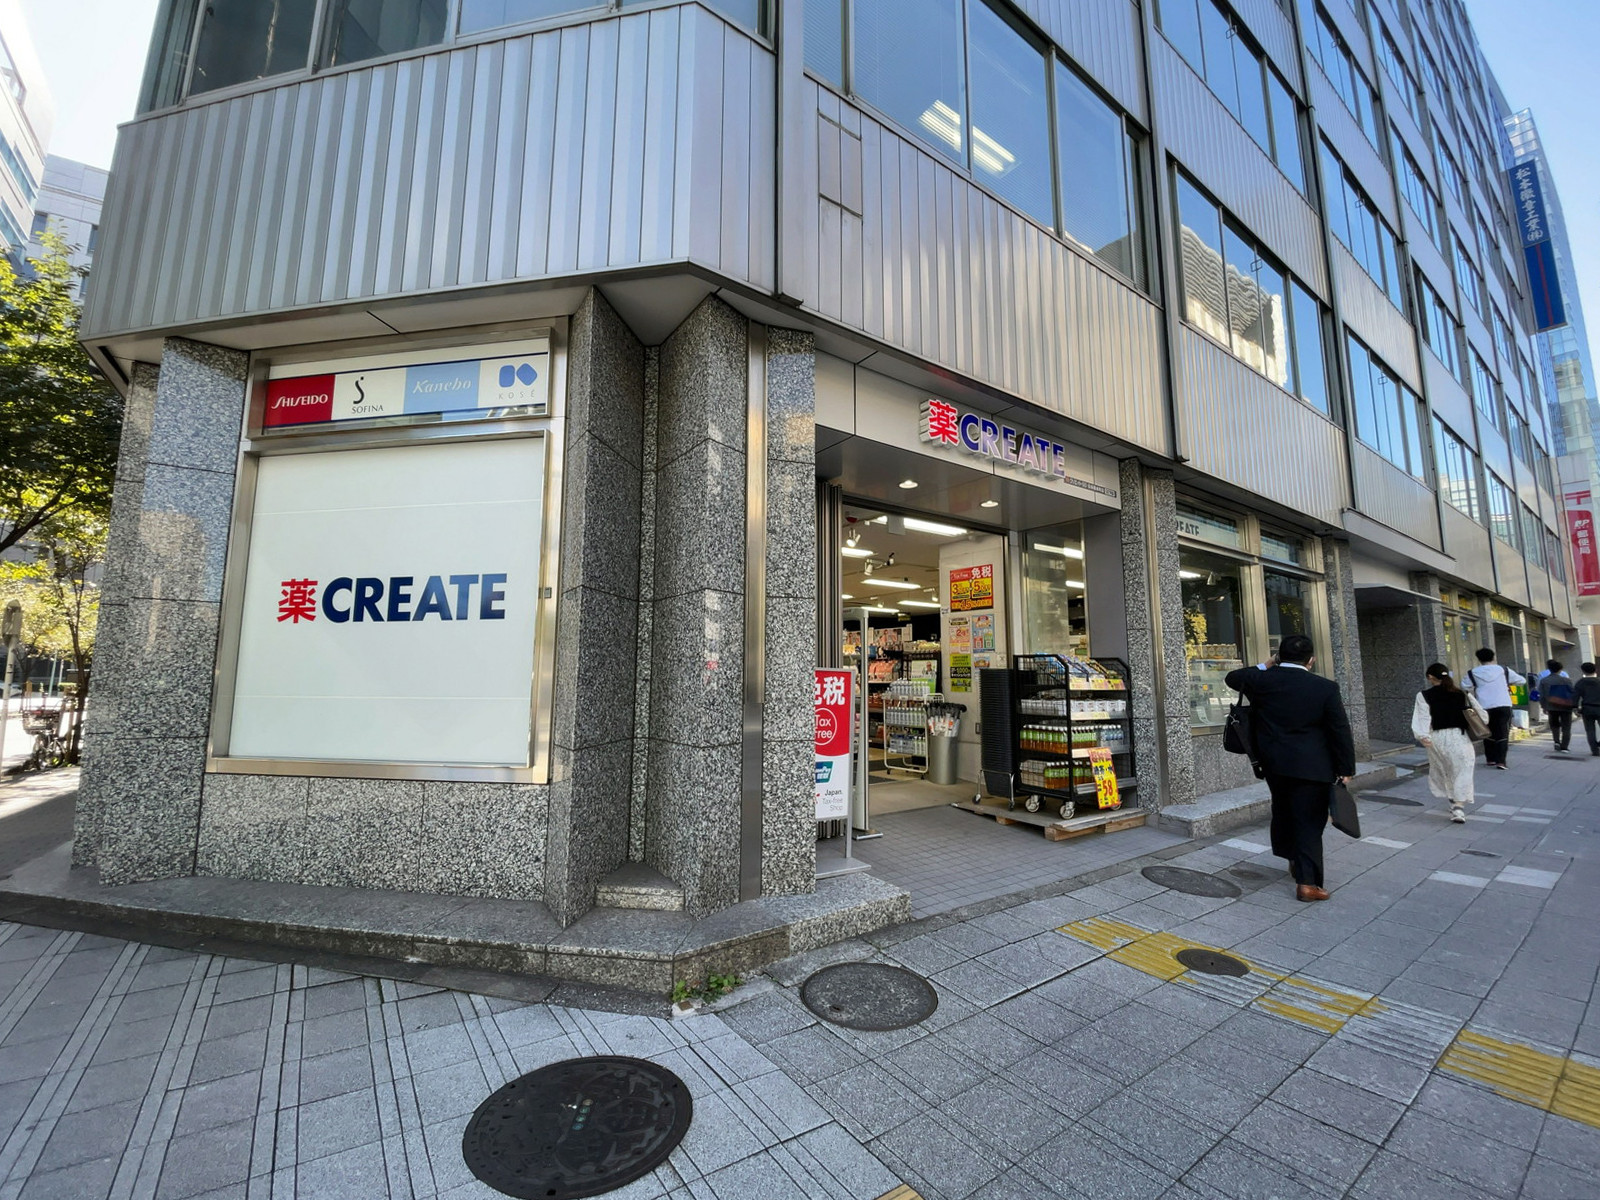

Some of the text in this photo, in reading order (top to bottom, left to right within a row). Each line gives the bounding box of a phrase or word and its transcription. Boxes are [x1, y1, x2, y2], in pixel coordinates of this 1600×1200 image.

[412, 377, 472, 394] Kanebo
[271, 393, 329, 410] SHISEIDO
[498, 389, 536, 400] KOSÉ
[351, 405, 384, 415] SOFINA
[971, 565, 992, 579] 免税
[1102, 779, 1113, 797] 58
